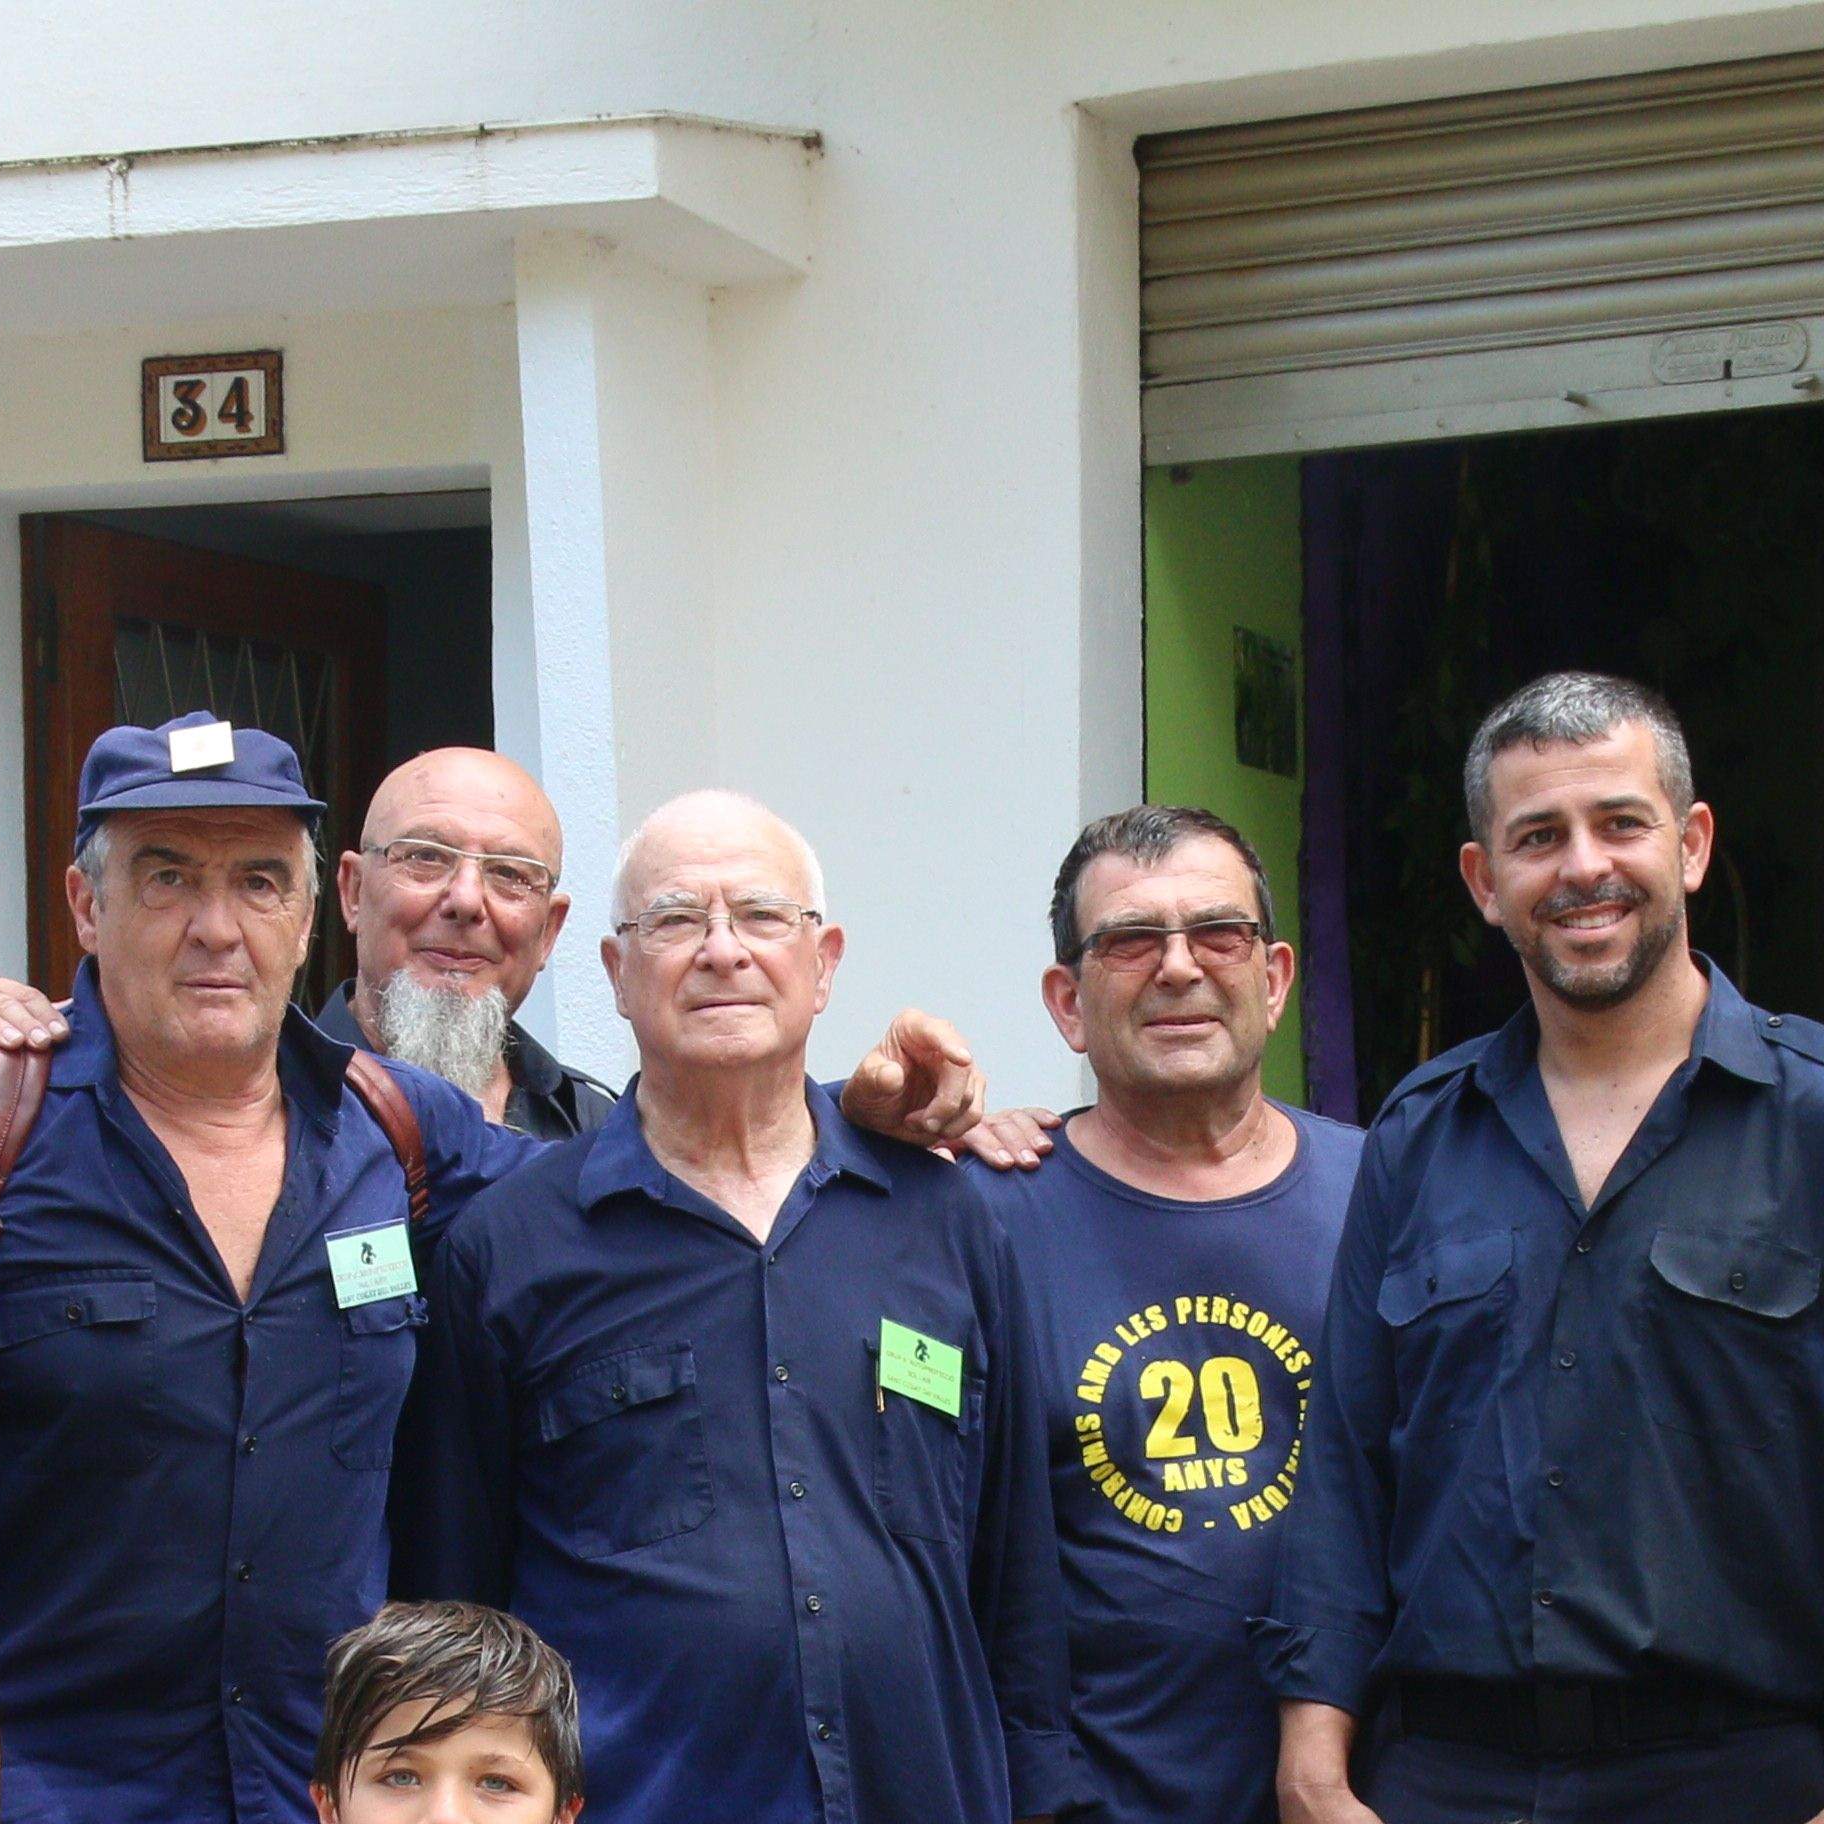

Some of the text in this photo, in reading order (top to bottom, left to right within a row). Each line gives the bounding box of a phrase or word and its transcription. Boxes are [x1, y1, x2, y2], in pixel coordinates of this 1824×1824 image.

[172, 376, 255, 437] 34
[1076, 1342, 1124, 1404] AMB
[1114, 1304, 1169, 1347] LES
[1174, 1295, 1313, 1374] PERSONES
[1139, 1356, 1265, 1459] 20
[1163, 1457, 1249, 1492] ANYS
